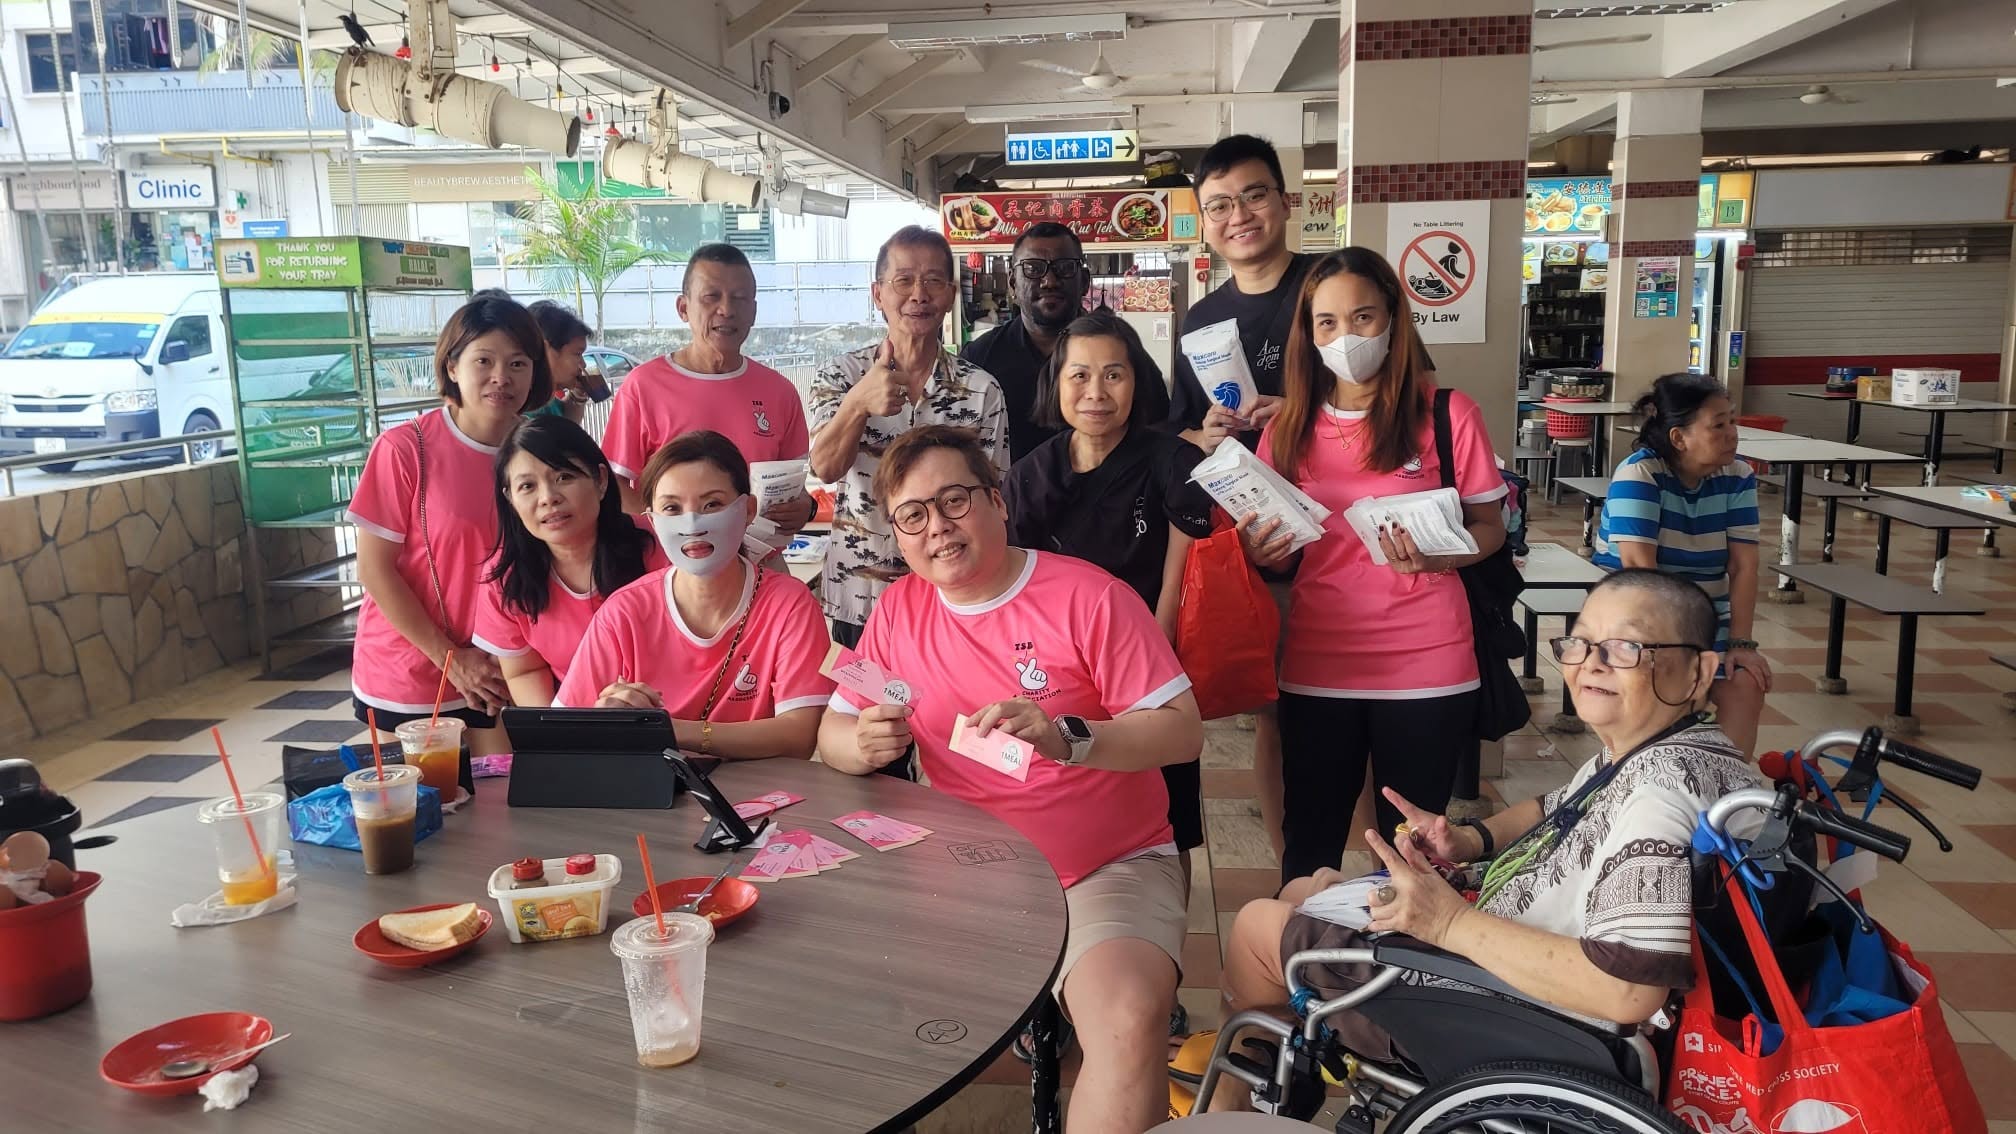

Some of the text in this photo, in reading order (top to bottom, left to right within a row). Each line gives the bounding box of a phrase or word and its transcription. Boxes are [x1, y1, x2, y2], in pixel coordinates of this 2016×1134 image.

[16, 178, 101, 192] neghbourood
[481, 175, 530, 185] AESTHETI
[138, 179, 202, 199] Clinic
[1093, 220, 1113, 235] Teh
[1303, 222, 1330, 233] ew
[275, 242, 335, 253] THANK YOU
[265, 255, 348, 267] FOR RETURNING
[279, 270, 337, 280] YOUR TRAY
[1412, 311, 1460, 325] By Law
[1014, 641, 1034, 651] TSB
[883, 687, 908, 705] 1MEAL
[1021, 688, 1050, 696] CHARITY
[1001, 751, 1022, 767] 1MEAL
[1678, 1067, 1738, 1088] PROJEC
[1793, 1063, 1840, 1080] SOCIETY
